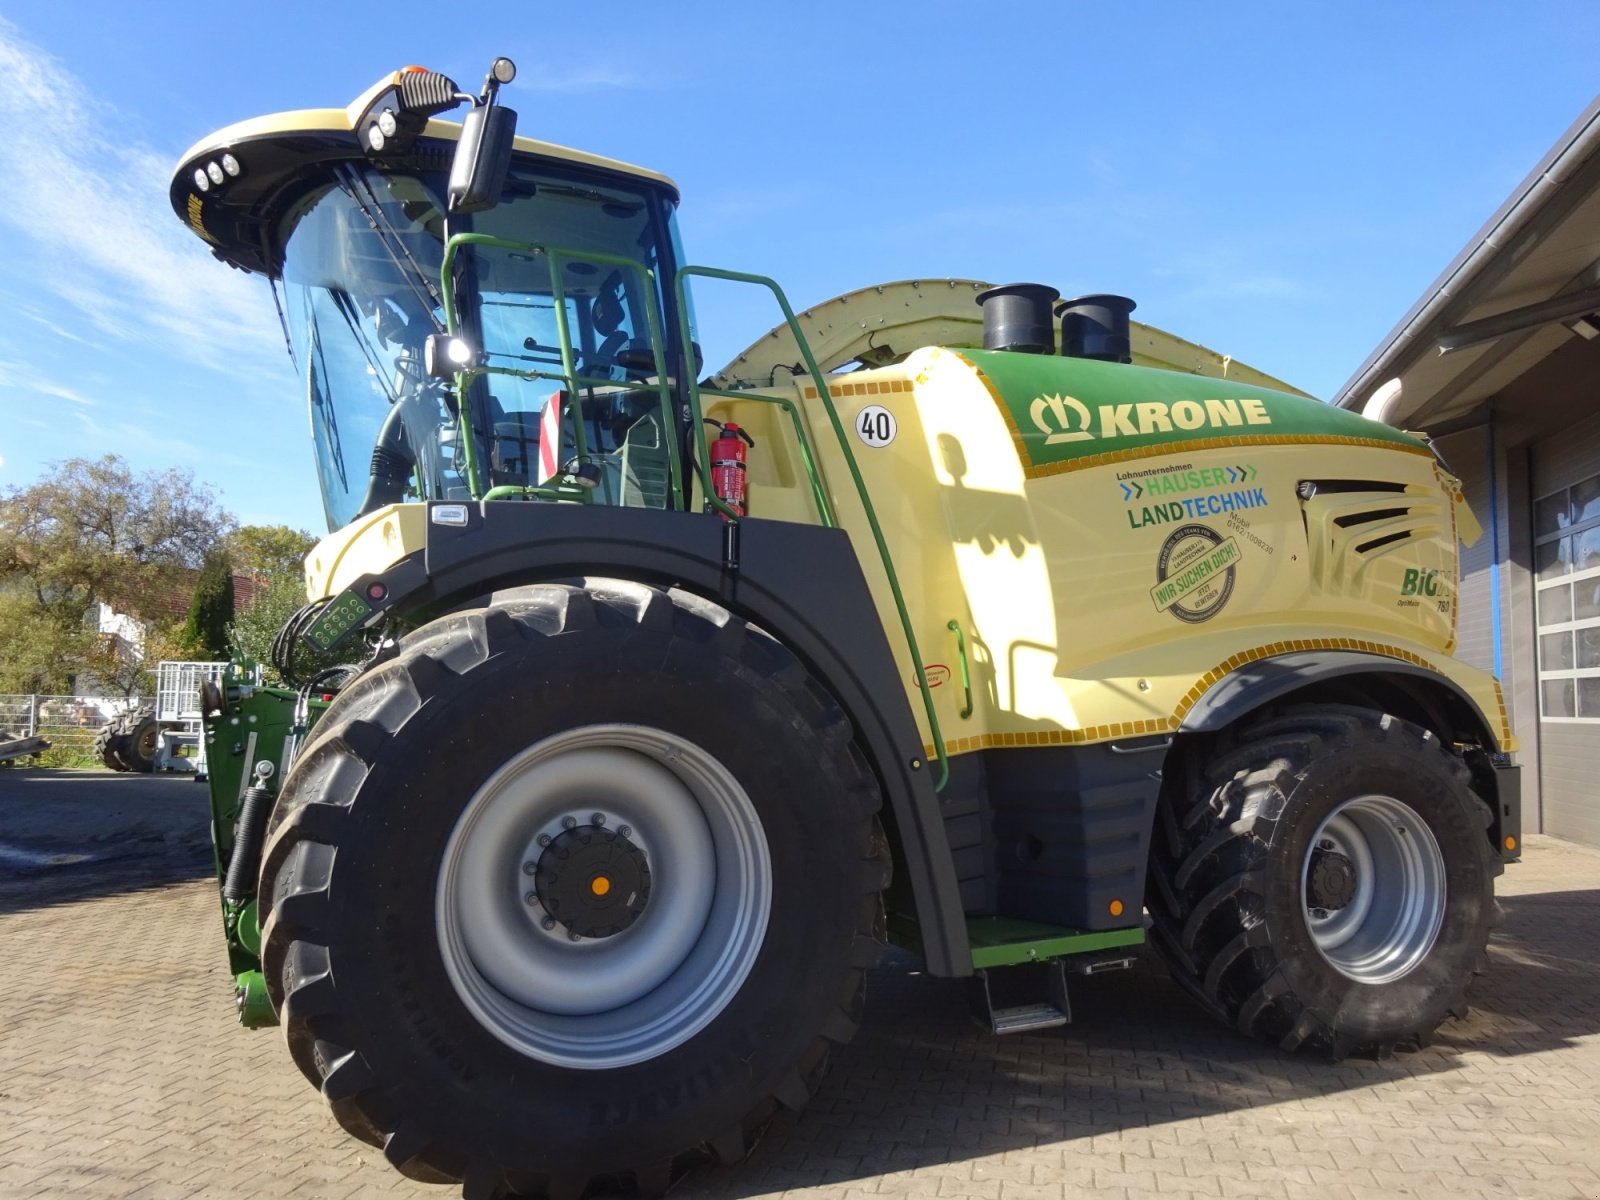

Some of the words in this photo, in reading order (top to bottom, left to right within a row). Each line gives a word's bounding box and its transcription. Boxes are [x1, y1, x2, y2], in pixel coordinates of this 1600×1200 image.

[862, 412, 890, 441] 40
[1098, 399, 1271, 438] KRONE
[1116, 463, 1193, 481] Lohnunternehmen
[1145, 467, 1228, 497] HAUSER
[1127, 487, 1268, 529] LANDTECHNIK
[1230, 512, 1250, 528] Mobil
[1156, 583, 1177, 605] WIR
[1175, 559, 1213, 592] SUCHEN
[1211, 543, 1237, 569] DICH!
[1400, 567, 1438, 597] BiG
